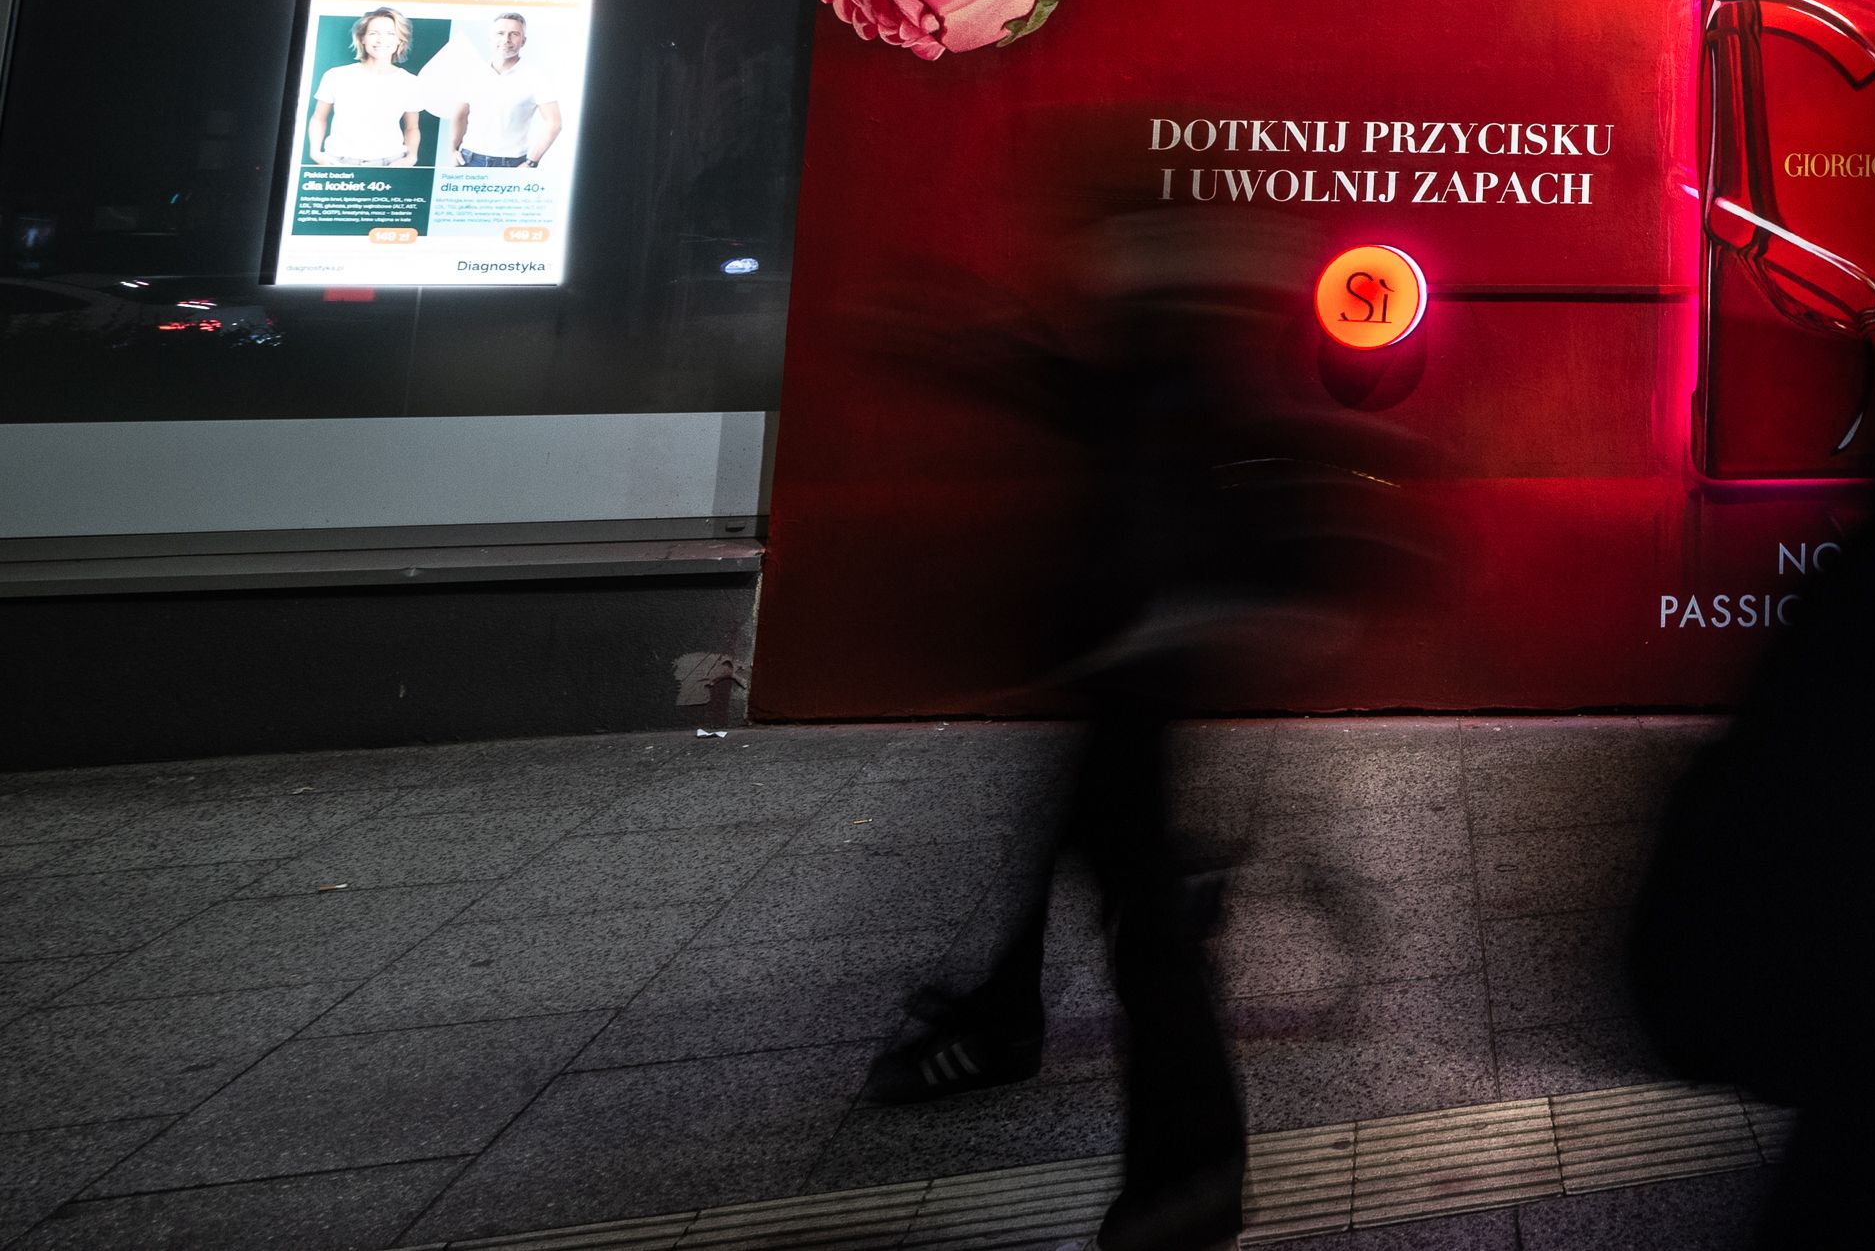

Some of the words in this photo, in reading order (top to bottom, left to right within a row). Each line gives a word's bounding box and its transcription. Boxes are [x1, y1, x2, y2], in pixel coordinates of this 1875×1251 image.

[1148, 118, 1349, 154] DOTKNIJ
[1362, 121, 1615, 156] PRZYCISKU
[302, 181, 323, 191] dla
[325, 181, 365, 191] kobiet
[367, 181, 392, 191] 40+
[440, 183, 459, 192] dla
[461, 183, 521, 194] mężczyzn
[523, 184, 546, 193] 40+
[1158, 168, 1176, 201] I
[1190, 168, 1400, 203] UWOLNIJ
[1412, 171, 1594, 205] ZAPACH
[457, 260, 545, 274] Diagnostyka
[1337, 271, 1395, 323] Sì
